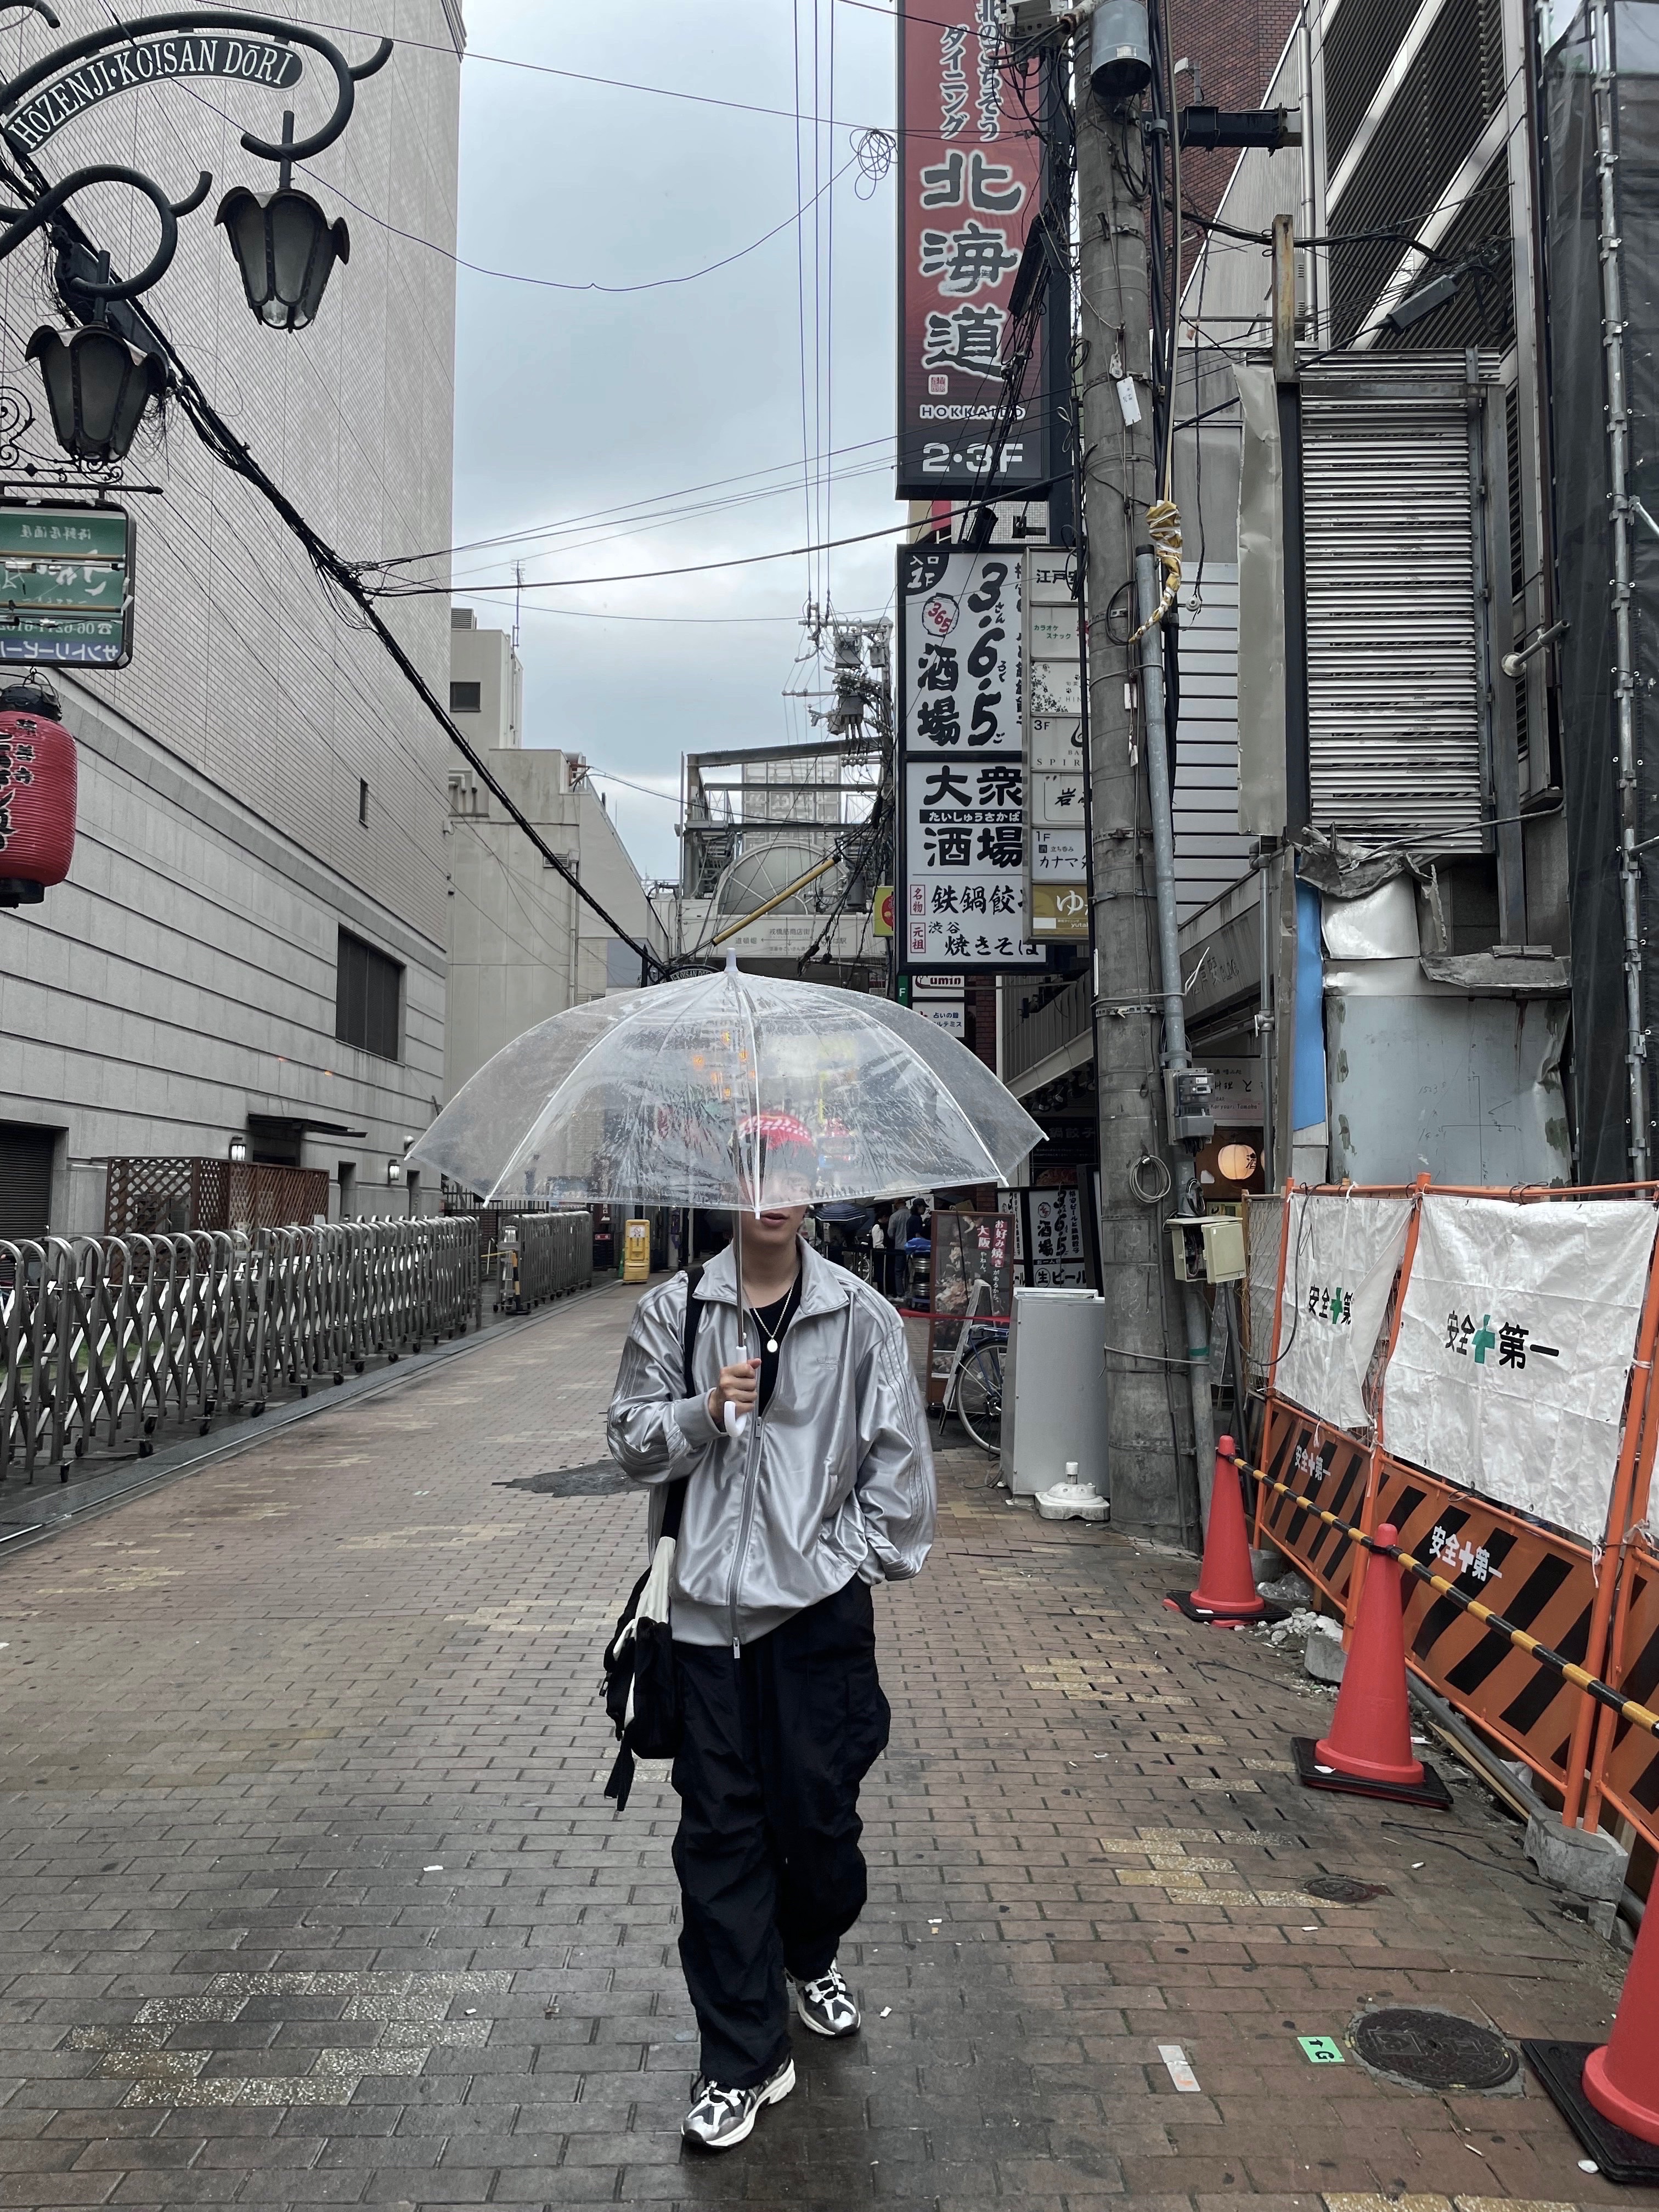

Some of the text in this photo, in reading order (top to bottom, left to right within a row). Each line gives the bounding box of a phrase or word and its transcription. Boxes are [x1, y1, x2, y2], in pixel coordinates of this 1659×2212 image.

[939, 24, 970, 140] ダイニング
[920, 149, 1025, 382] 北海道
[919, 404, 1025, 420] HOKKAIDO
[909, 555, 939, 566] 入口
[907, 567, 935, 589] 1F
[928, 602, 952, 633] 365
[995, 602, 1005, 624] さん
[997, 660, 1007, 682] ろく
[917, 643, 961, 747] 酒場
[1034, 720, 1050, 730] 3F
[993, 732, 1005, 744] ご
[923, 765, 1023, 807] 大衆
[929, 811, 1021, 822] たいしゅうさかば
[923, 826, 1023, 868] 酒場
[1036, 831, 1051, 842] 1F
[913, 887, 923, 915] 名物
[931, 884, 1023, 915] 鉄鍋餃
[912, 926, 924, 951] 元祖
[928, 921, 961, 934] 渋谷
[1037, 1220, 1053, 1256] 酒場
